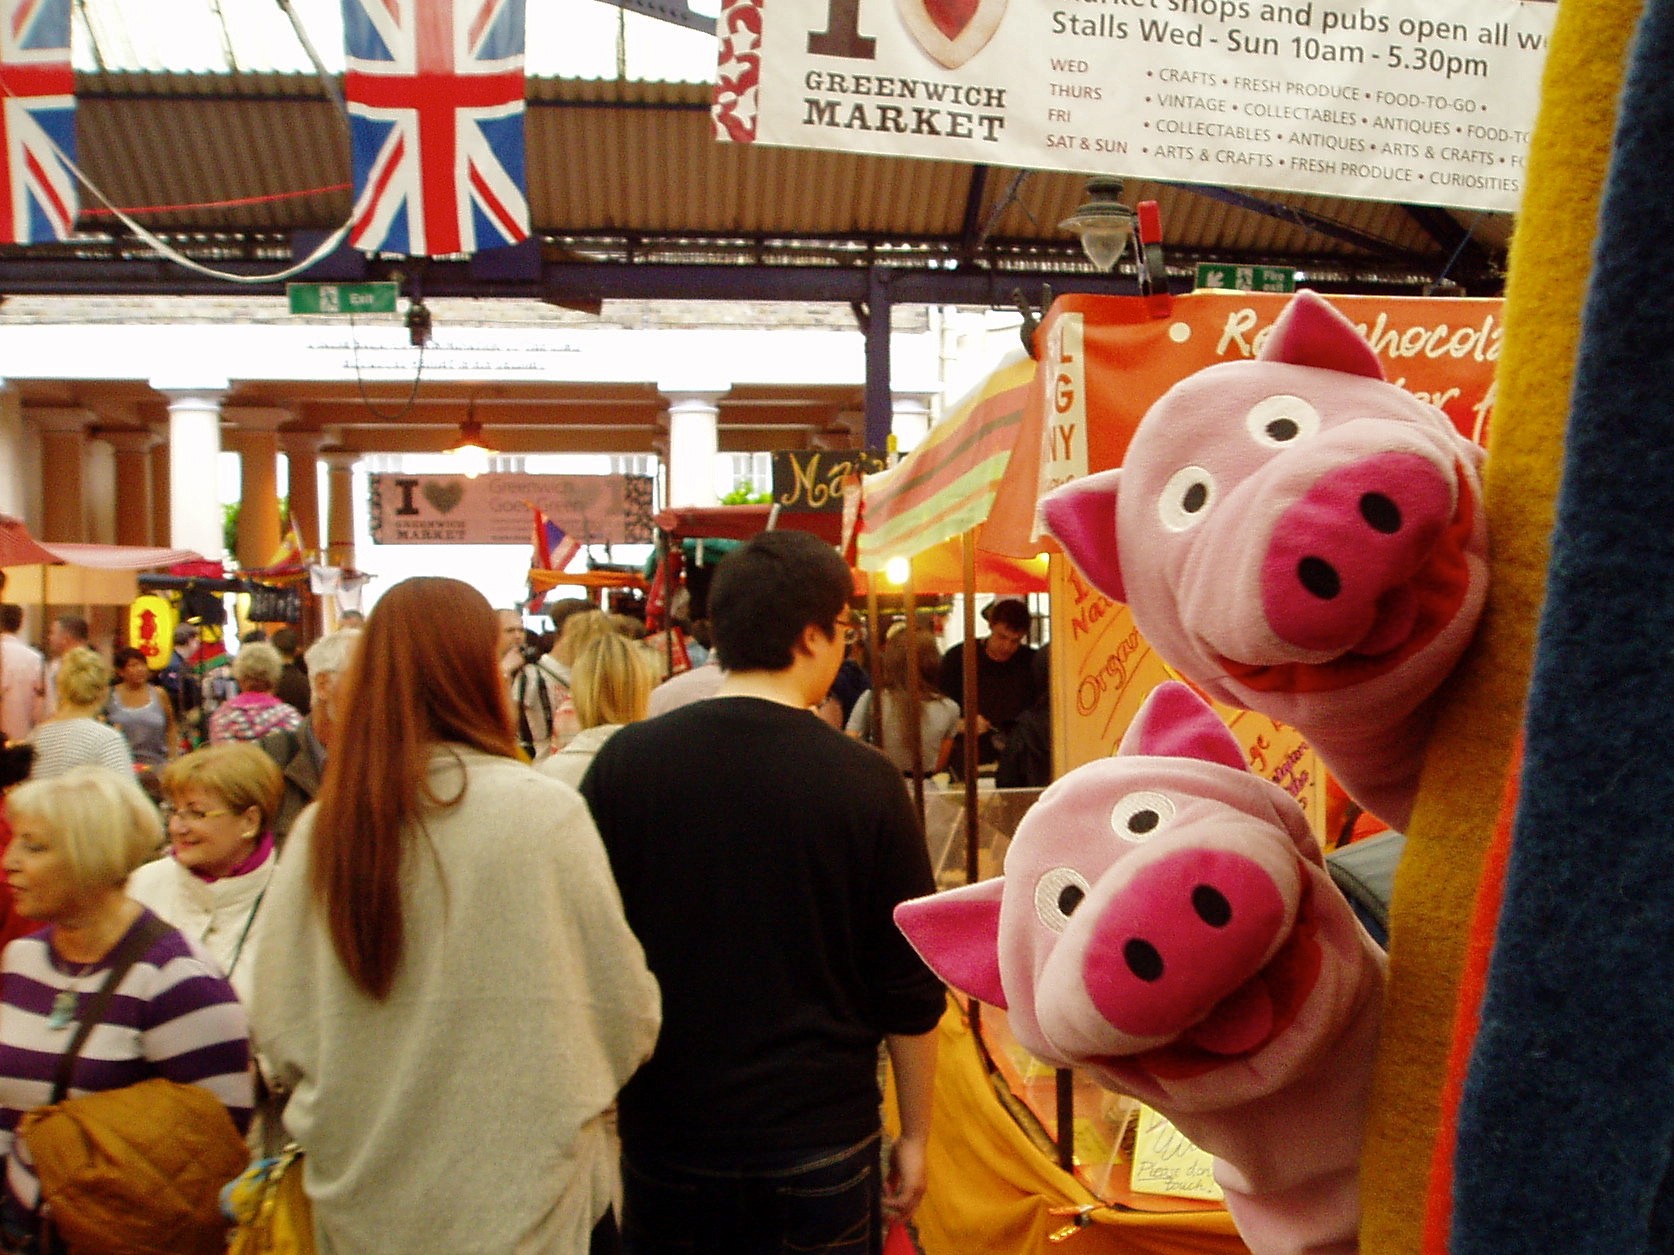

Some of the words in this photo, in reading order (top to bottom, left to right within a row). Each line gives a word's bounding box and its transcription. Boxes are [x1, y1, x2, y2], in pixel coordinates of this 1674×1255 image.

[1052, 10, 1128, 39] Stalls
[1139, 18, 1203, 47] Wed
[1227, 28, 1279, 56] Sun
[1291, 36, 1364, 63] 10am
[1387, 44, 1488, 78] 5.30pm
[1168, 0, 1250, 22] shops
[1260, 2, 1312, 26] and
[1322, 8, 1389, 34] pubs
[1399, 17, 1468, 43] open
[1478, 22, 1508, 46] all
[804, 69, 1007, 108] GREENWICH
[1050, 58, 1088, 73] WED
[1159, 68, 1217, 86] CRAFTS
[1234, 77, 1281, 93] FRESH
[1286, 82, 1360, 101] PRODUCE
[1376, 90, 1477, 112] FOOD-TO-GO
[1050, 83, 1102, 100] THURS
[1157, 94, 1227, 112] VINTAGE
[1244, 102, 1357, 126] COLLECTABLES
[1373, 116, 1450, 135] ANTIQUES
[802, 97, 1005, 142] MARKET
[1048, 109, 1071, 123] FRI
[1156, 119, 1271, 142] COLLECTABLES
[1289, 132, 1366, 152] ANTIQUES
[1381, 142, 1419, 158] ARTS
[1424, 146, 1436, 160] &
[1441, 146, 1495, 166] CRAFTS
[1047, 134, 1076, 149] SAT
[1079, 137, 1091, 151] &
[1095, 139, 1128, 154] SUN
[1154, 145, 1194, 161] ARTS
[1199, 149, 1210, 162] &
[1215, 150, 1273, 168] CRAFTS
[1290, 157, 1336, 174] FRESH
[1341, 162, 1412, 182] PRODUCE
[1430, 171, 1519, 193] CURIOSITIES
[395, 478, 420, 515] I
